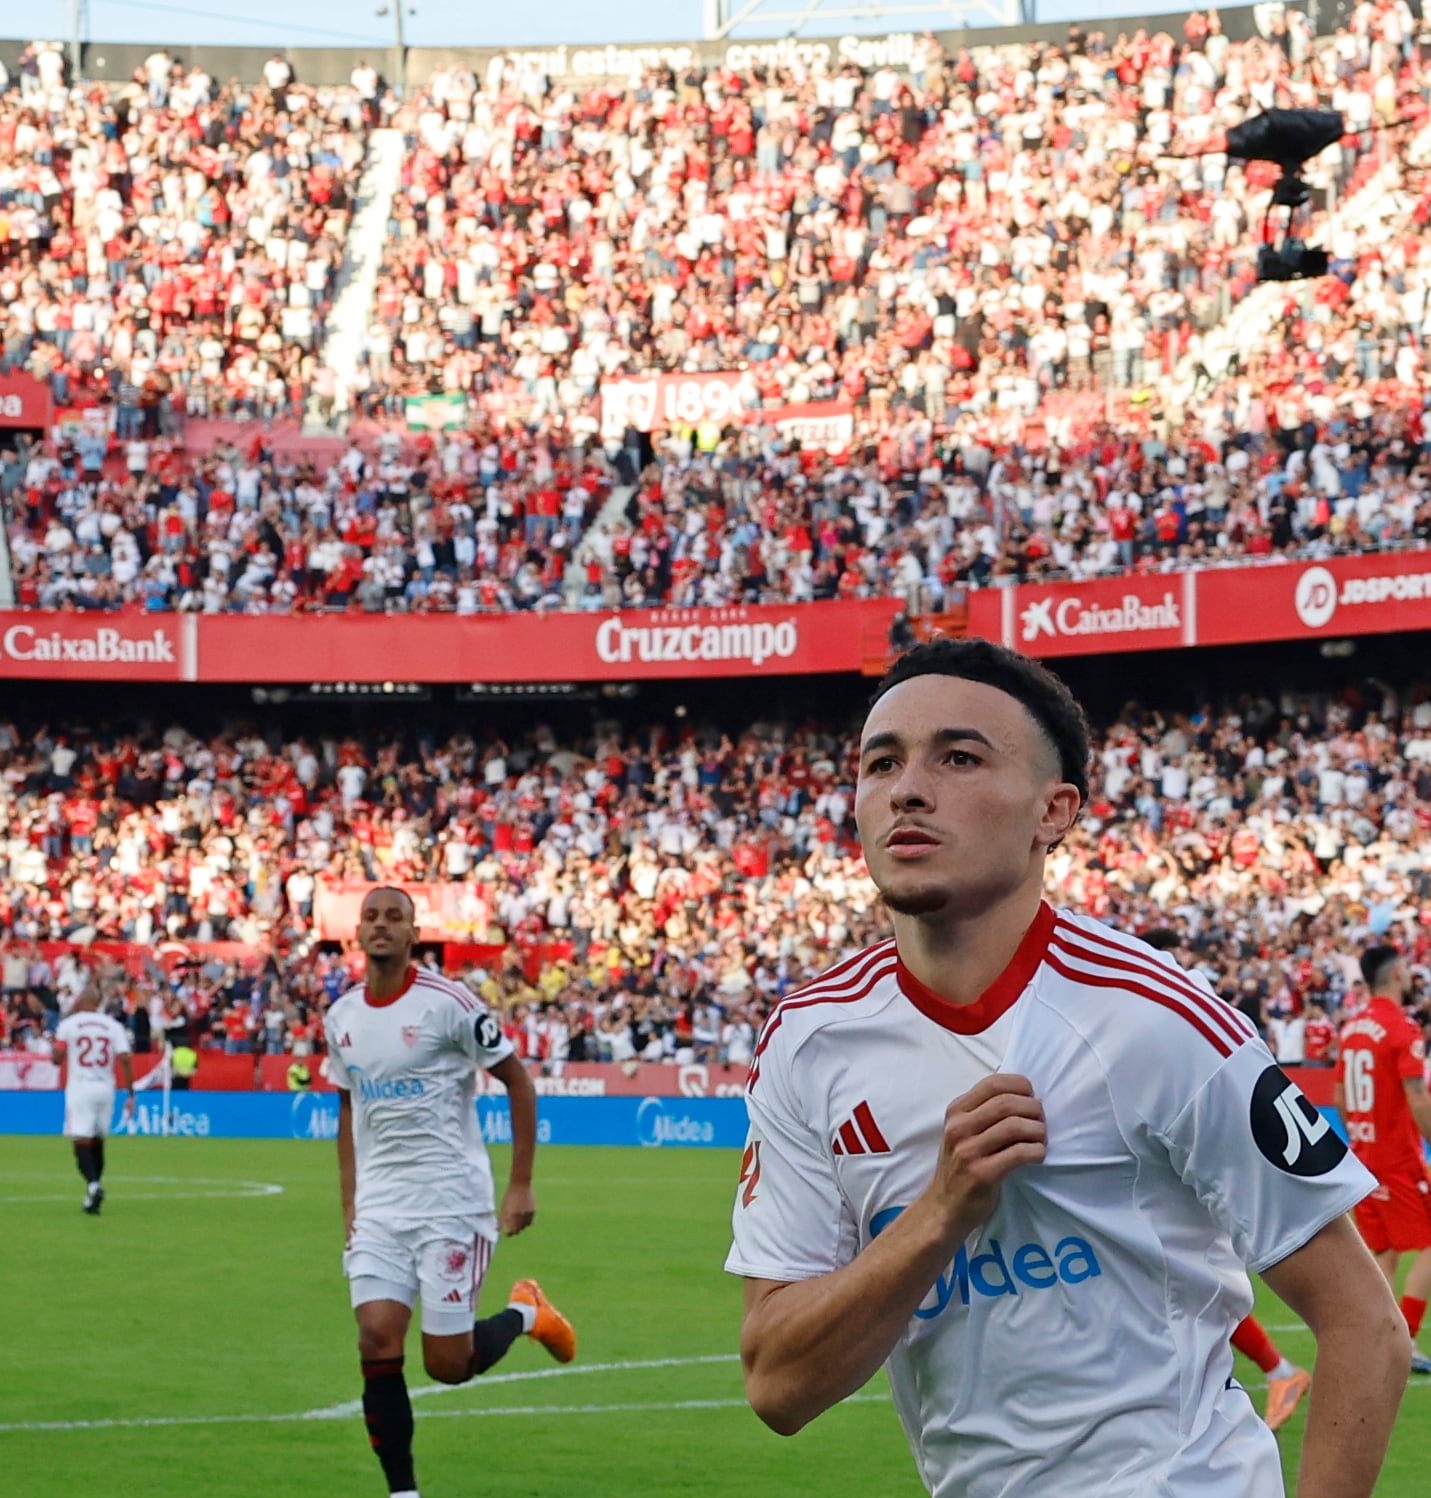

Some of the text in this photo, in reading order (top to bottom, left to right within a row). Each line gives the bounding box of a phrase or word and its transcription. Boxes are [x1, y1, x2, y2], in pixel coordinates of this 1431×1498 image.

[1056, 591, 1182, 636] CaixaBank
[3, 624, 175, 662] CaixaBank
[595, 615, 798, 666] Cruzcampo
[76, 1035, 111, 1068] 23
[1343, 1048, 1375, 1113] 16
[648, 1114, 715, 1145] Midea
[1272, 1085, 1331, 1167] JD
[914, 1236, 1102, 1320] Mdea
